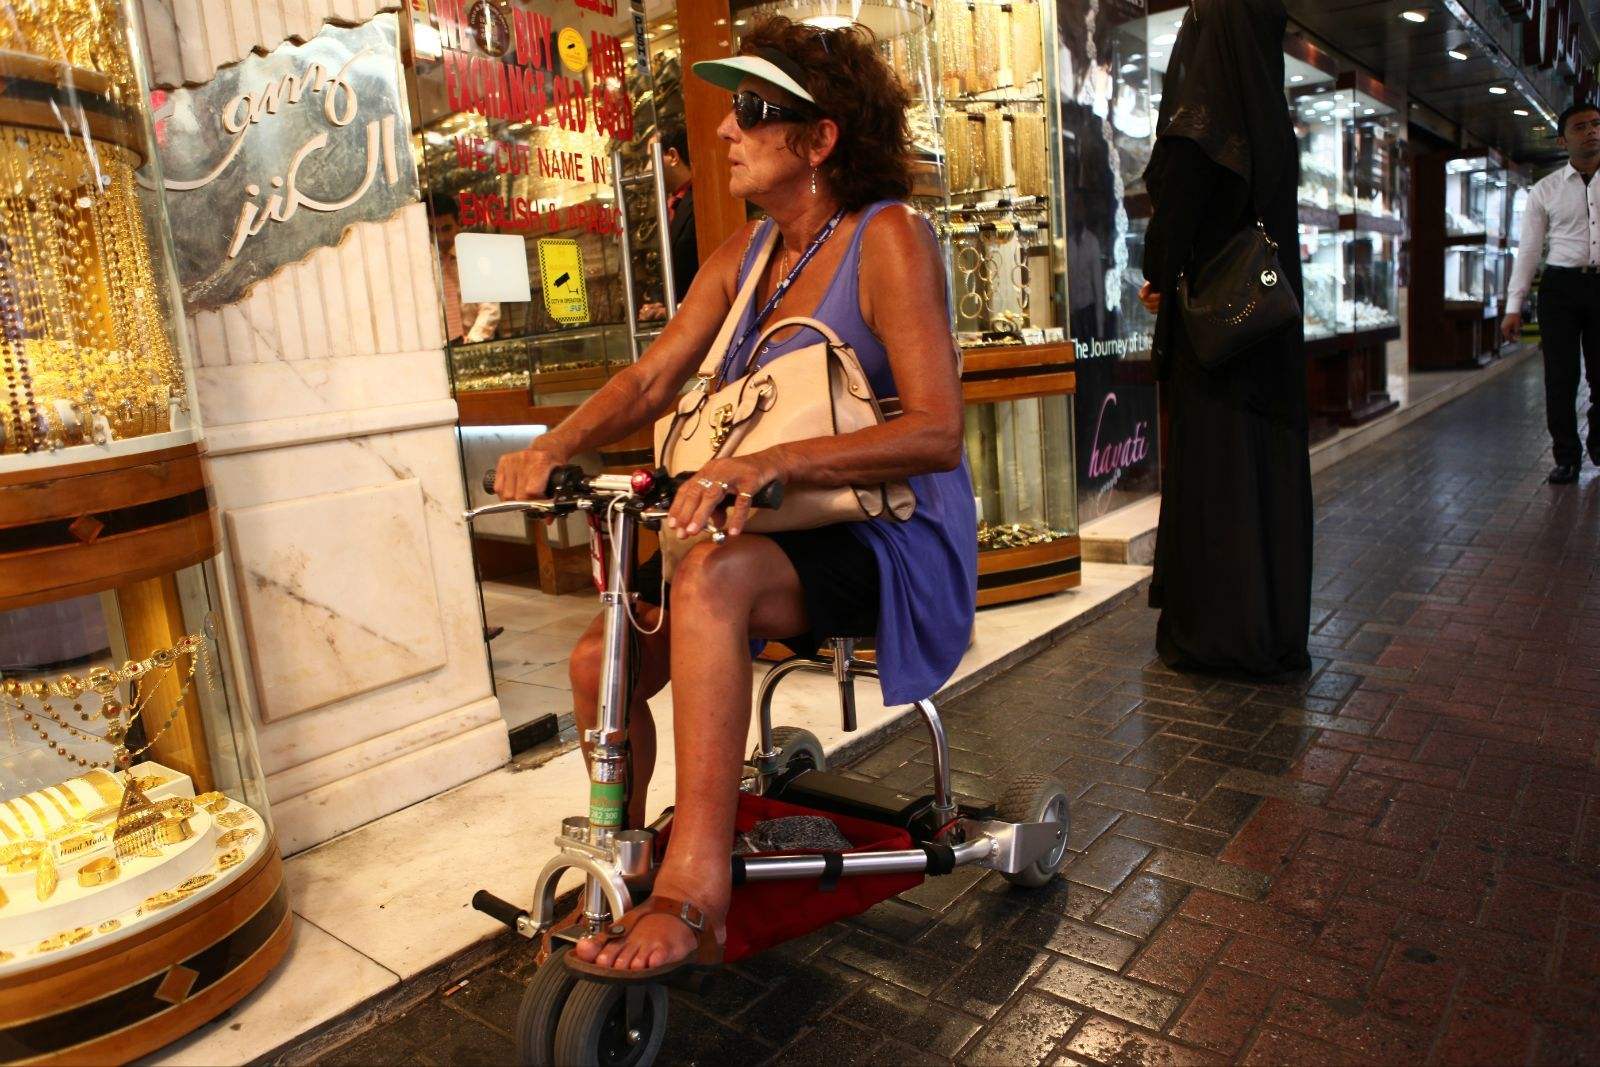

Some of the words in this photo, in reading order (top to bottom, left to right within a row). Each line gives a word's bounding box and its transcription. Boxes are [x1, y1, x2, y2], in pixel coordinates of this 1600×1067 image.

[512, 6, 553, 71] BUY
[443, 49, 550, 127] EXCHANGE
[553, 74, 587, 133] OLD
[455, 135, 488, 173] WE
[495, 139, 530, 176] CUT
[537, 147, 586, 182] NAME
[591, 154, 607, 184] IN
[459, 191, 541, 230] ENGLISH
[1090, 337, 1127, 359] Journey
[1129, 331, 1138, 353] of
